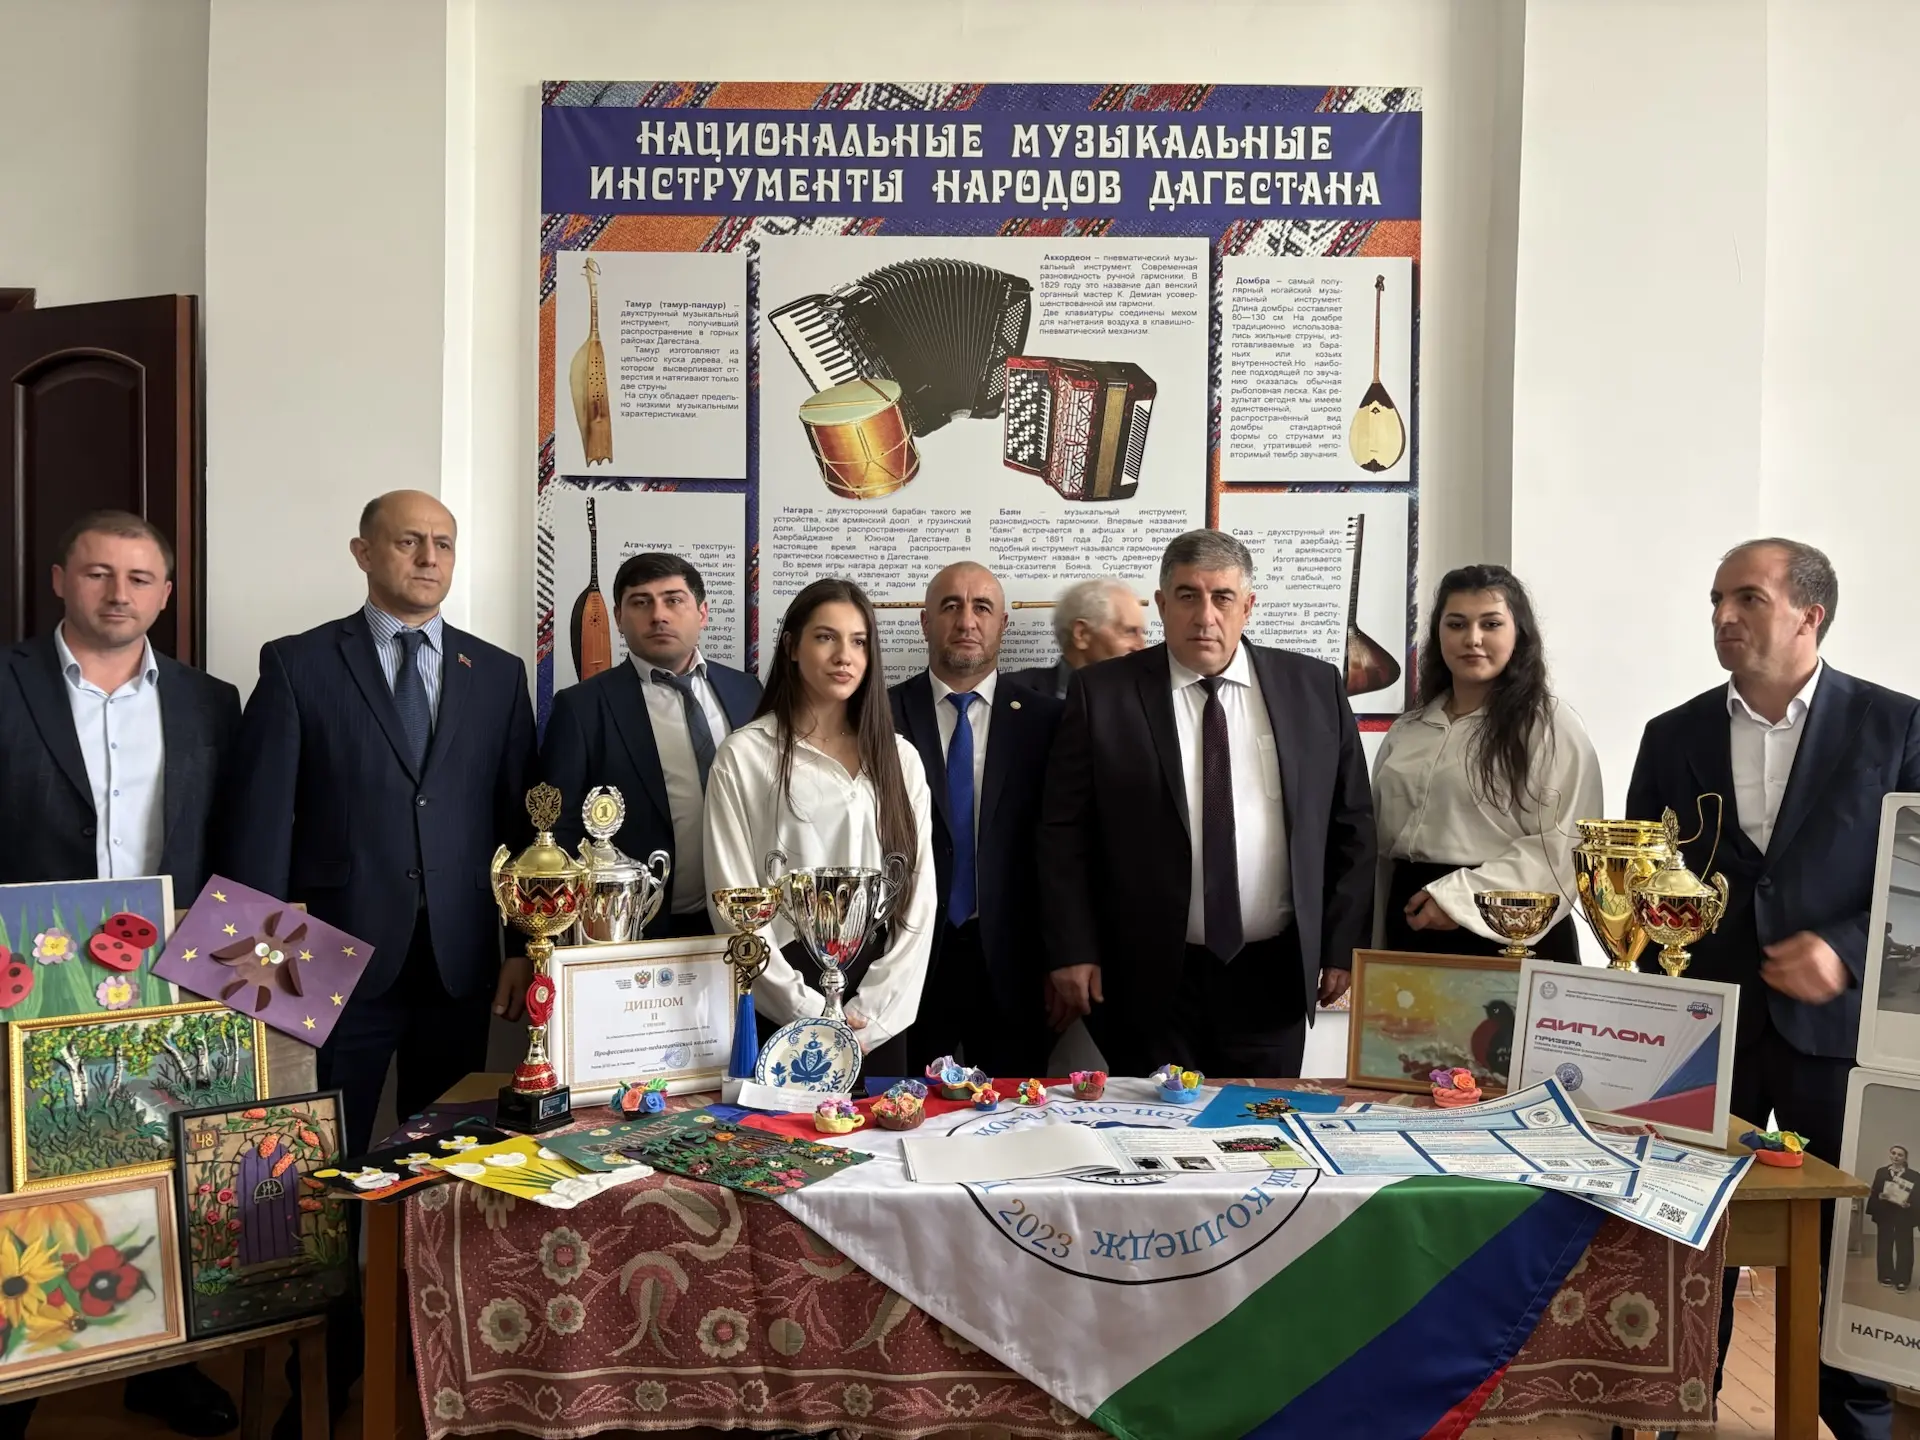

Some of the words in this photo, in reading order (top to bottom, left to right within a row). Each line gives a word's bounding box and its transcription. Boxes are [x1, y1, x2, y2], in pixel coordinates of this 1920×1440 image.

[636, 120, 983, 163] НАЦИОНАЛЬНЫЕ
[1011, 123, 1332, 161] МУЗЫКАЛЬНЫЕ
[590, 165, 903, 203] ИНСТРУМЕНТЫ
[931, 169, 1122, 212] НАРОДОВ
[1148, 170, 1382, 212] ДАГЕСТАНА
[1043, 253, 1091, 262] Аккордеон
[1141, 263, 1198, 272] Современная
[1106, 272, 1136, 281] ручной
[1235, 277, 1270, 286] Домбра
[1039, 290, 1079, 299] органный
[1129, 290, 1162, 298] Демиан
[1232, 286, 1264, 295] лярный
[625, 300, 652, 309] Тамур
[659, 301, 726, 310] (тамур-пандур)
[1231, 304, 1258, 312] Длина
[1260, 304, 1294, 313] домбры
[620, 309, 679, 318] двухструнный
[682, 310, 739, 319] музыкальный
[1042, 308, 1060, 317] Две
[688, 319, 739, 328] получивший
[620, 336, 656, 345] районах
[634, 346, 660, 354] Тамур
[660, 392, 699, 400] обладает
[1229, 450, 1271, 459] вторимый
[1273, 450, 1299, 459] тембр
[783, 506, 814, 515] Нагара
[826, 507, 888, 516] двухсторонний
[892, 507, 927, 516] барабан
[1064, 508, 1120, 517] музыкальный
[1107, 517, 1144, 526] Впервые
[803, 524, 840, 533] Широкое
[1266, 528, 1325, 537] двухструнный
[623, 541, 672, 550] Агач-кумуз
[989, 544, 1030, 552] подобный
[998, 553, 1048, 562] Инструмент
[1102, 562, 1153, 571] Существуют
[600, 803, 608, 818] 1
[742, 942, 751, 956] 1
[624, 996, 684, 1013] ДИПЛОМ
[1536, 1017, 1665, 1047] ДИПЛОМ
[1534, 1034, 1582, 1047] ПРИЗЕРА
[196, 1132, 214, 1148] 48
[998, 1198, 1074, 1259] 2023
